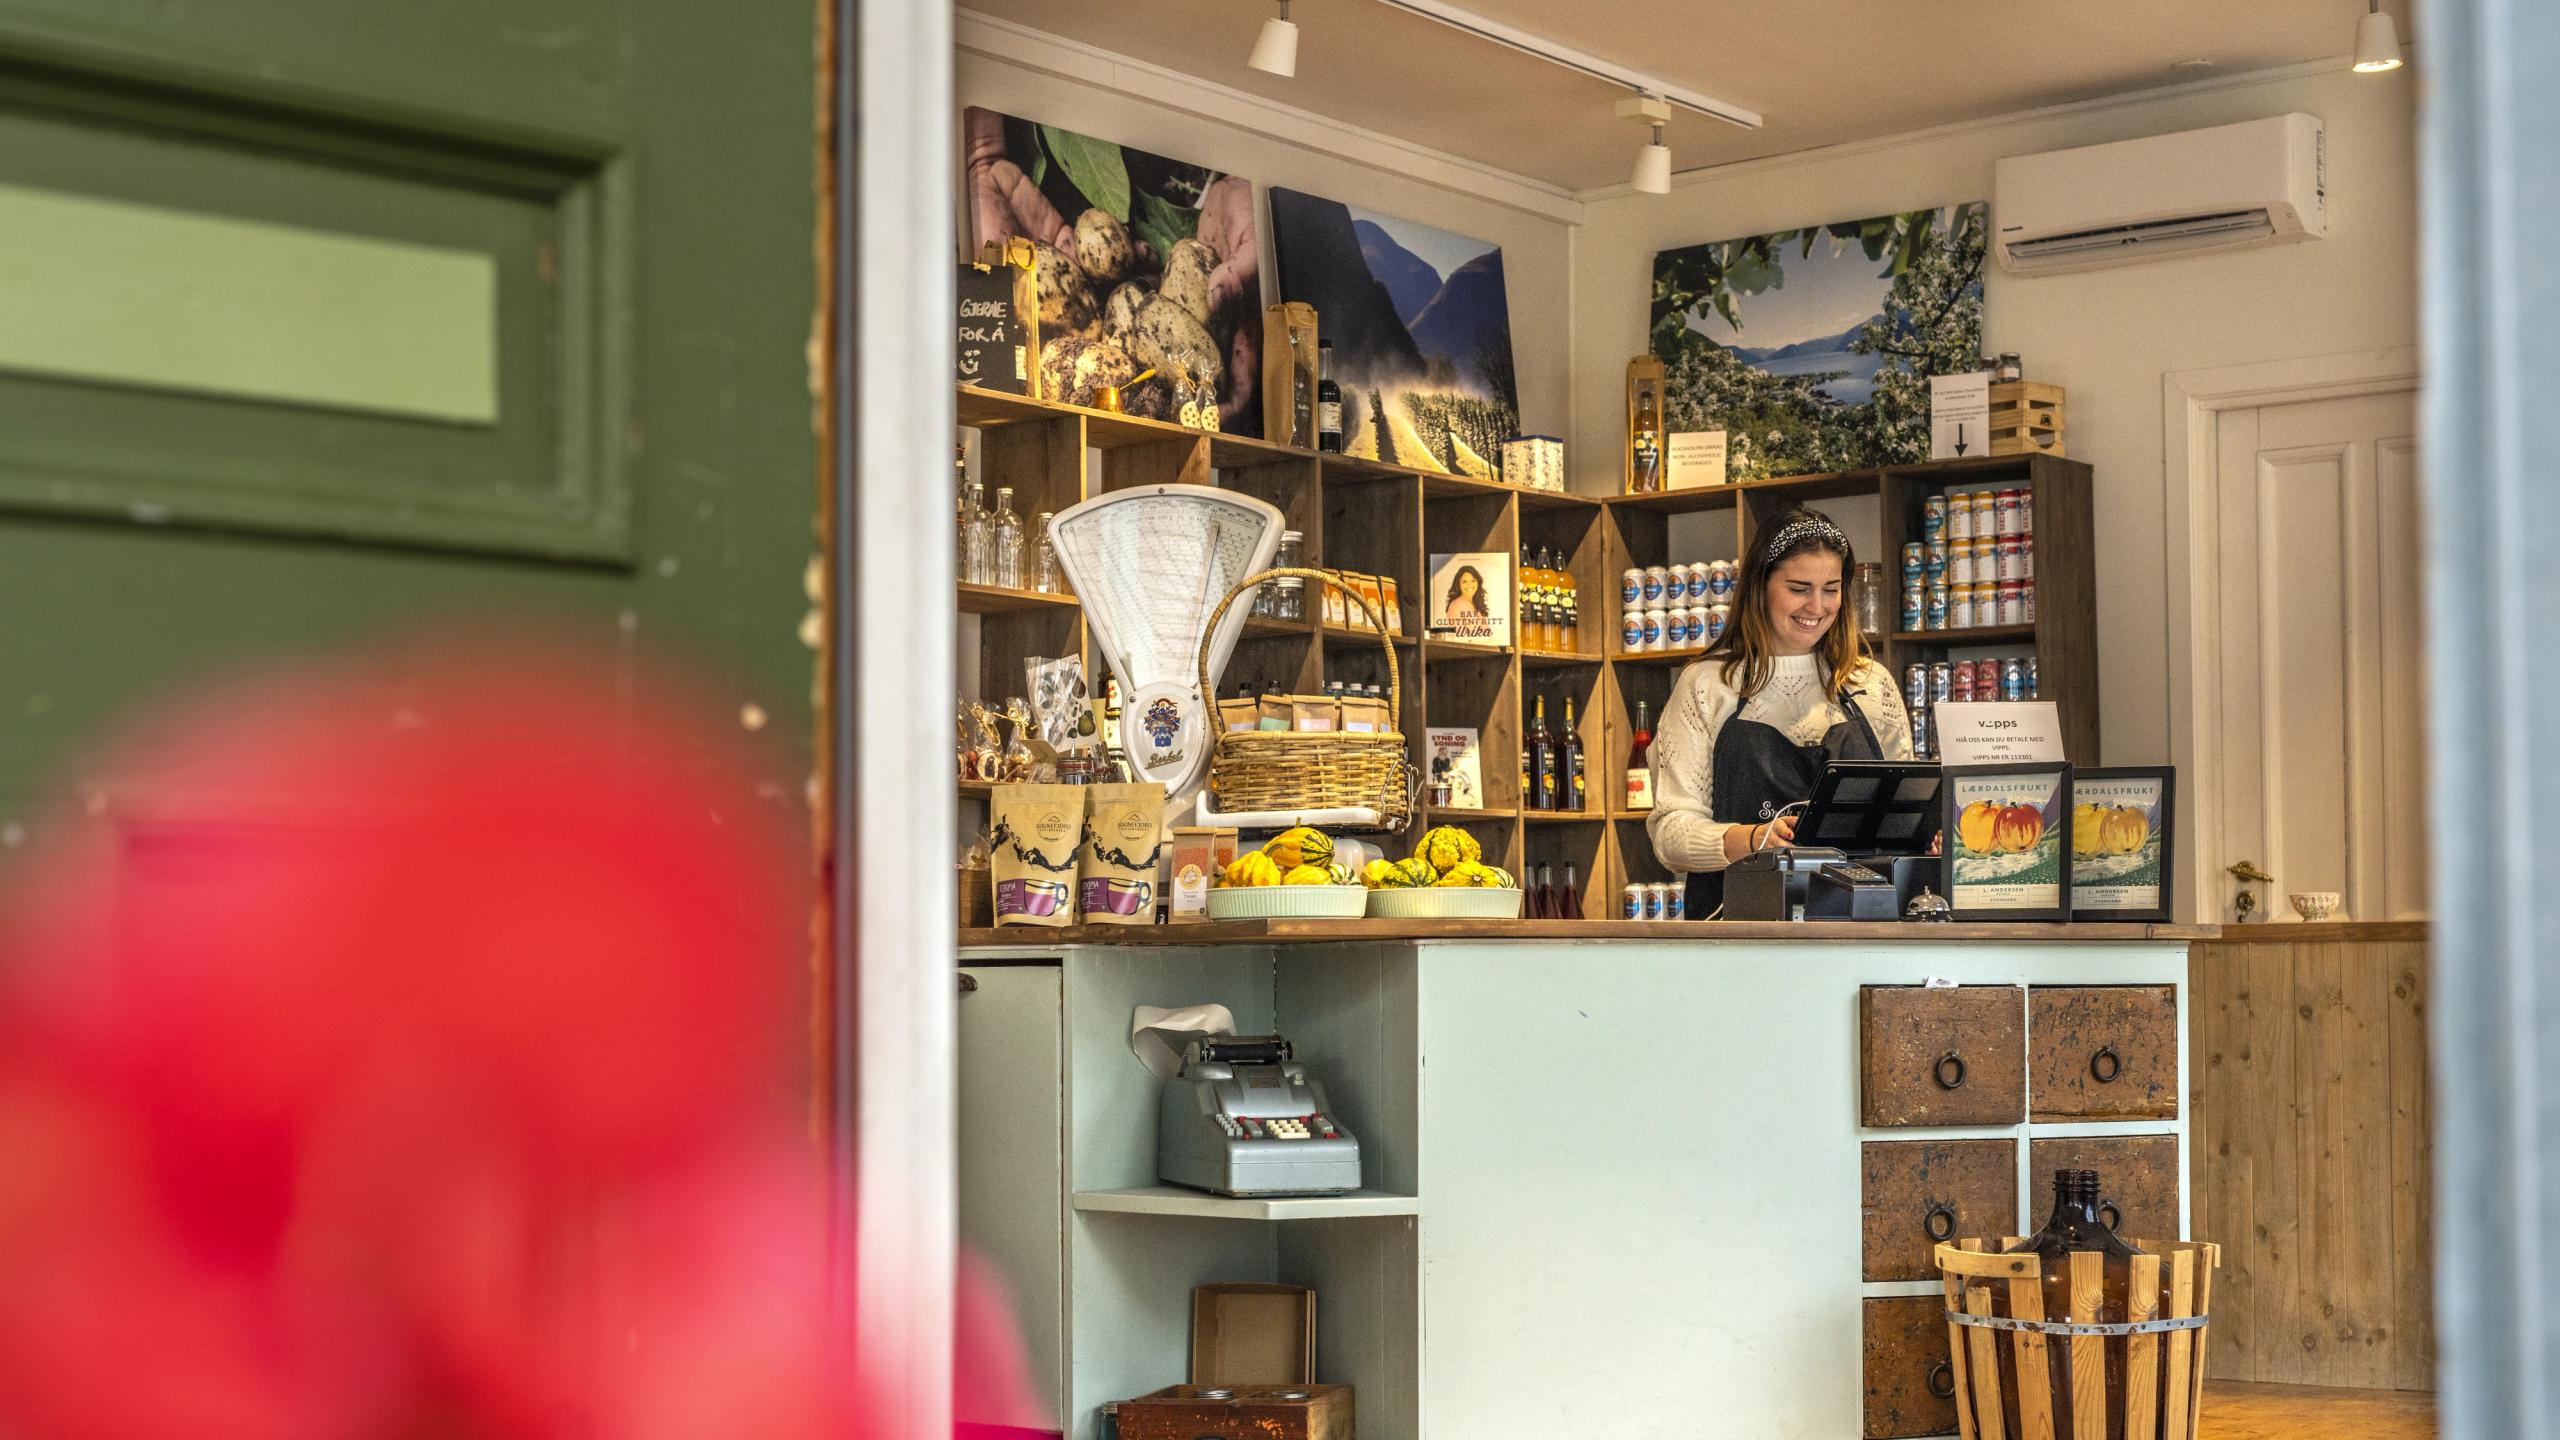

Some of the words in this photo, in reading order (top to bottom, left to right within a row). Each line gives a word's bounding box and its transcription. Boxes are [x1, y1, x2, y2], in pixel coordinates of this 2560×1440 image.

[959, 326, 990, 342] FOR
[1460, 610, 1479, 618] BAK
[1435, 618, 1504, 626] GLUTENFRITT
[1962, 784, 2048, 793] LÆRDALSFRUKT
[2075, 787, 2155, 795] ÆRDALSFRUKT
